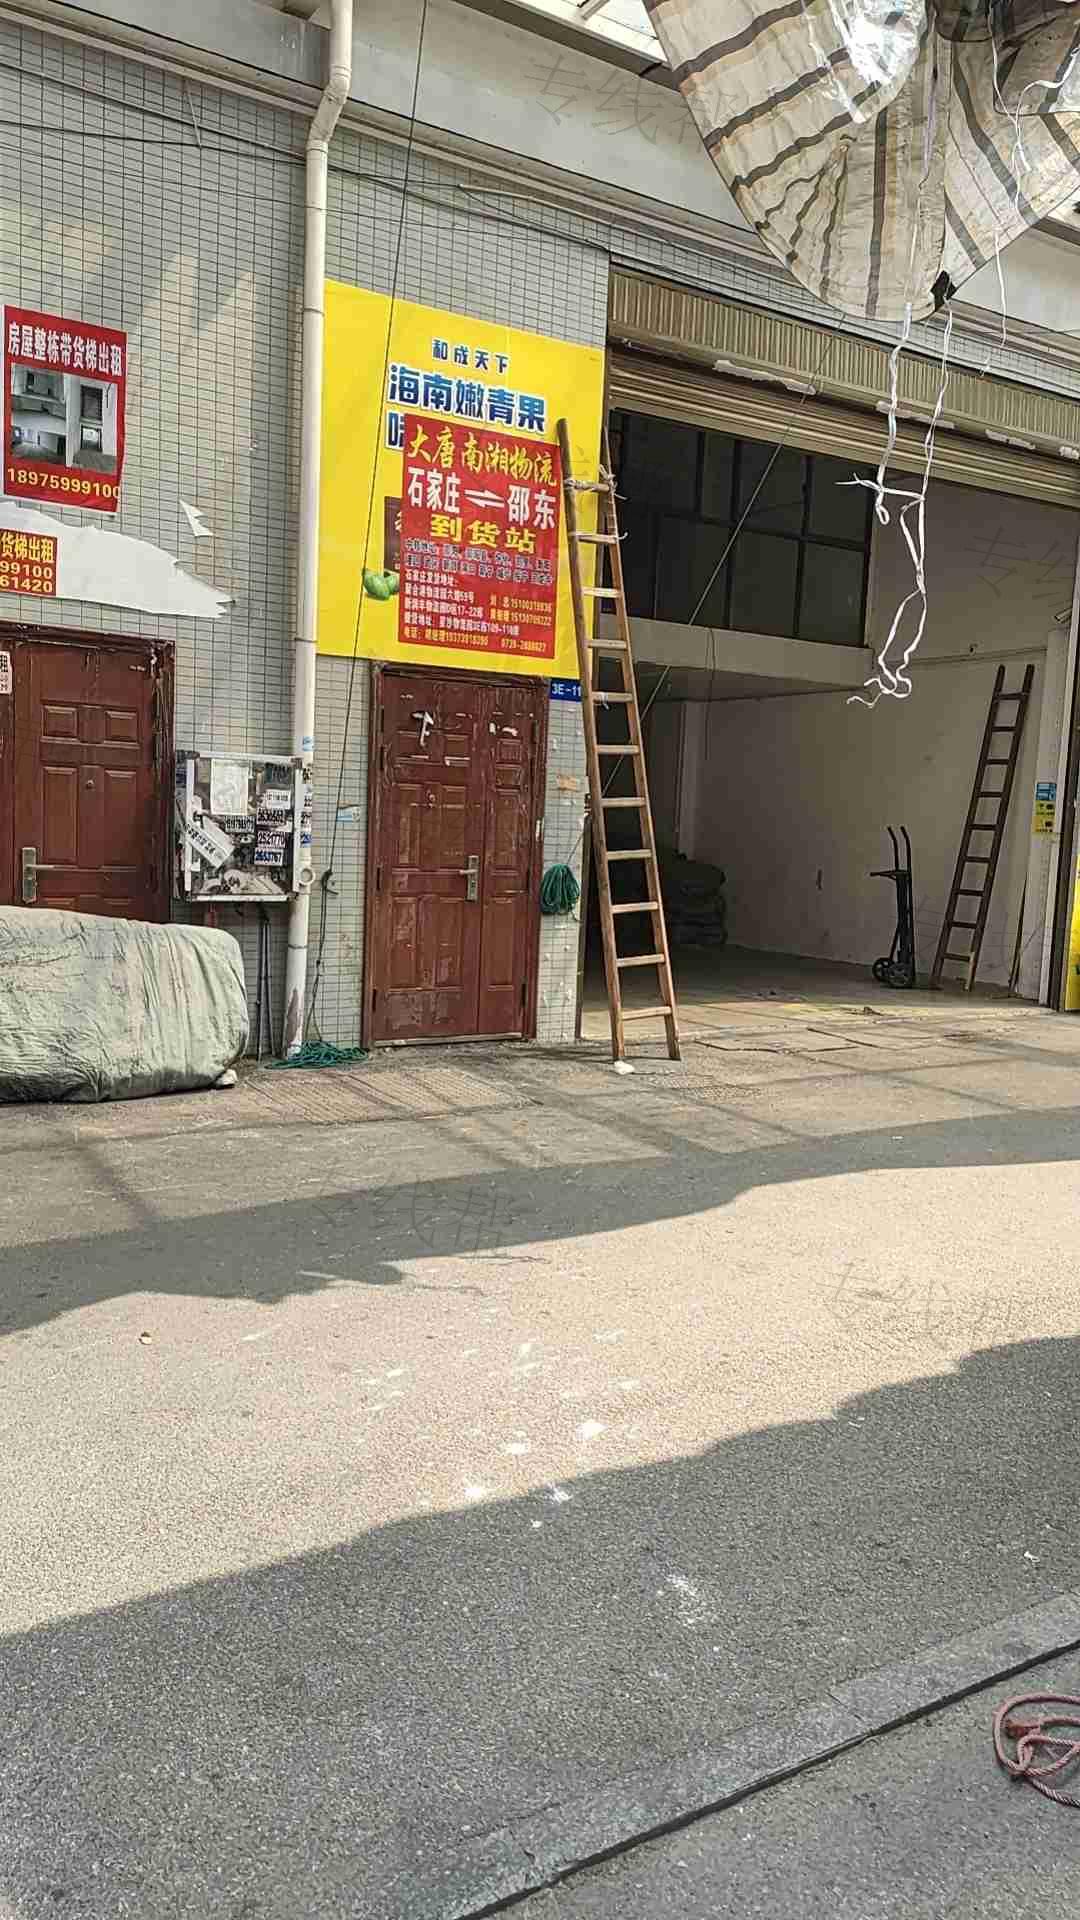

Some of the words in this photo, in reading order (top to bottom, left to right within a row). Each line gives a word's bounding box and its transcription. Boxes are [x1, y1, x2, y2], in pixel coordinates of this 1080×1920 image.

[8, 321, 123, 377] 房屋整栋带货梯出租
[432, 337, 510, 375] 和成天下
[388, 364, 547, 433] 海南嫩青果
[408, 423, 558, 487] 大唐南湘物流
[8, 468, 121, 498] 18975999100
[407, 466, 461, 515] 石家庄
[507, 485, 556, 532] 邵东
[0, 531, 55, 563] 货梯出租
[430, 514, 536, 555] 到货站
[0, 560, 53, 579] 99100
[0, 575, 53, 593] 61420
